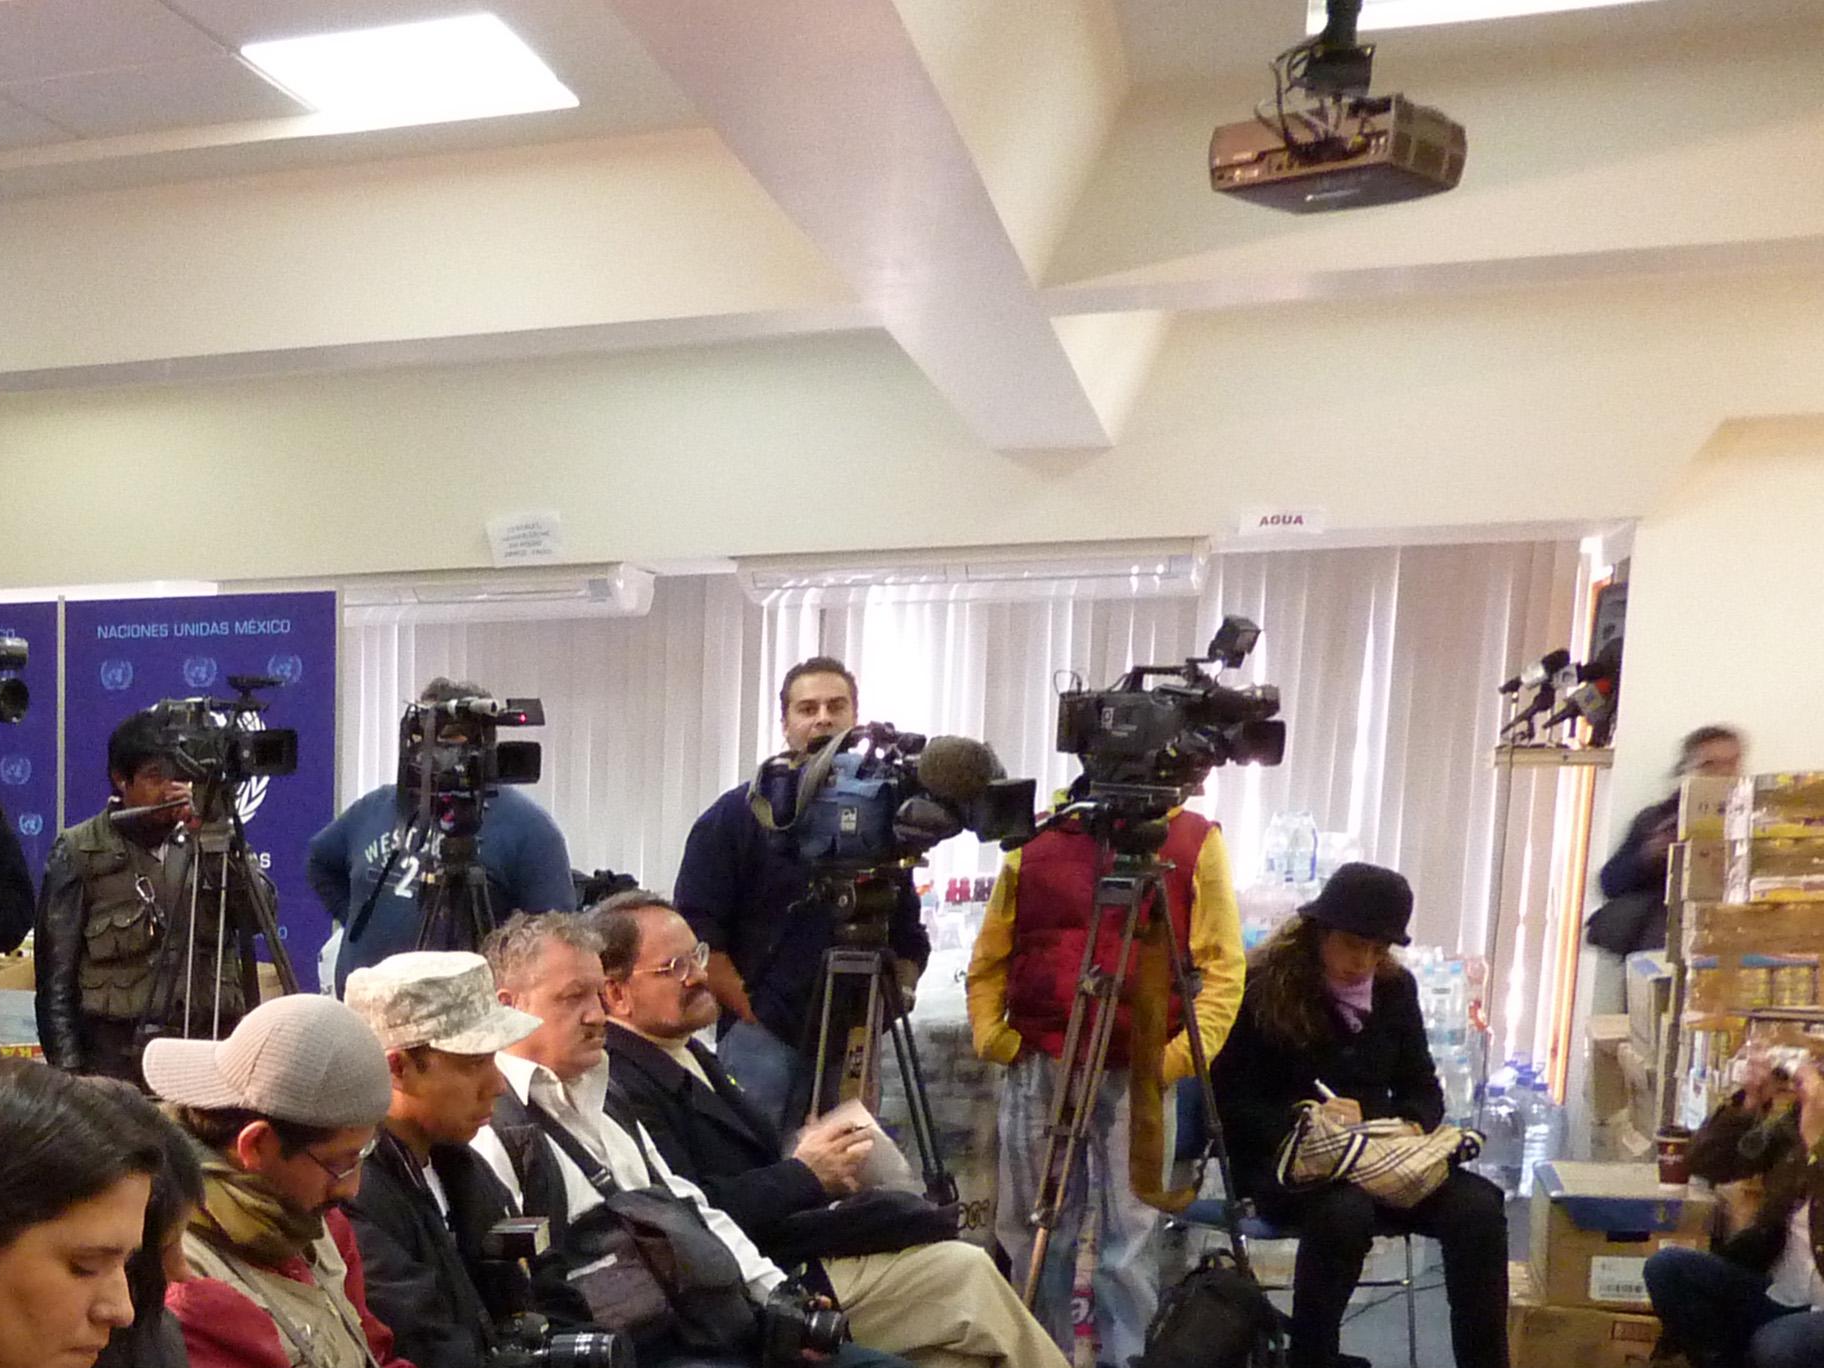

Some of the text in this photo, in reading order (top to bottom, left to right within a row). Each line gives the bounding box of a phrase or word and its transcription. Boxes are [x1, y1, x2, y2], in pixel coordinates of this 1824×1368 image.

[1258, 514, 1304, 527] AGUA
[97, 617, 291, 640] NACIONES UNIDAS MÉXICO
